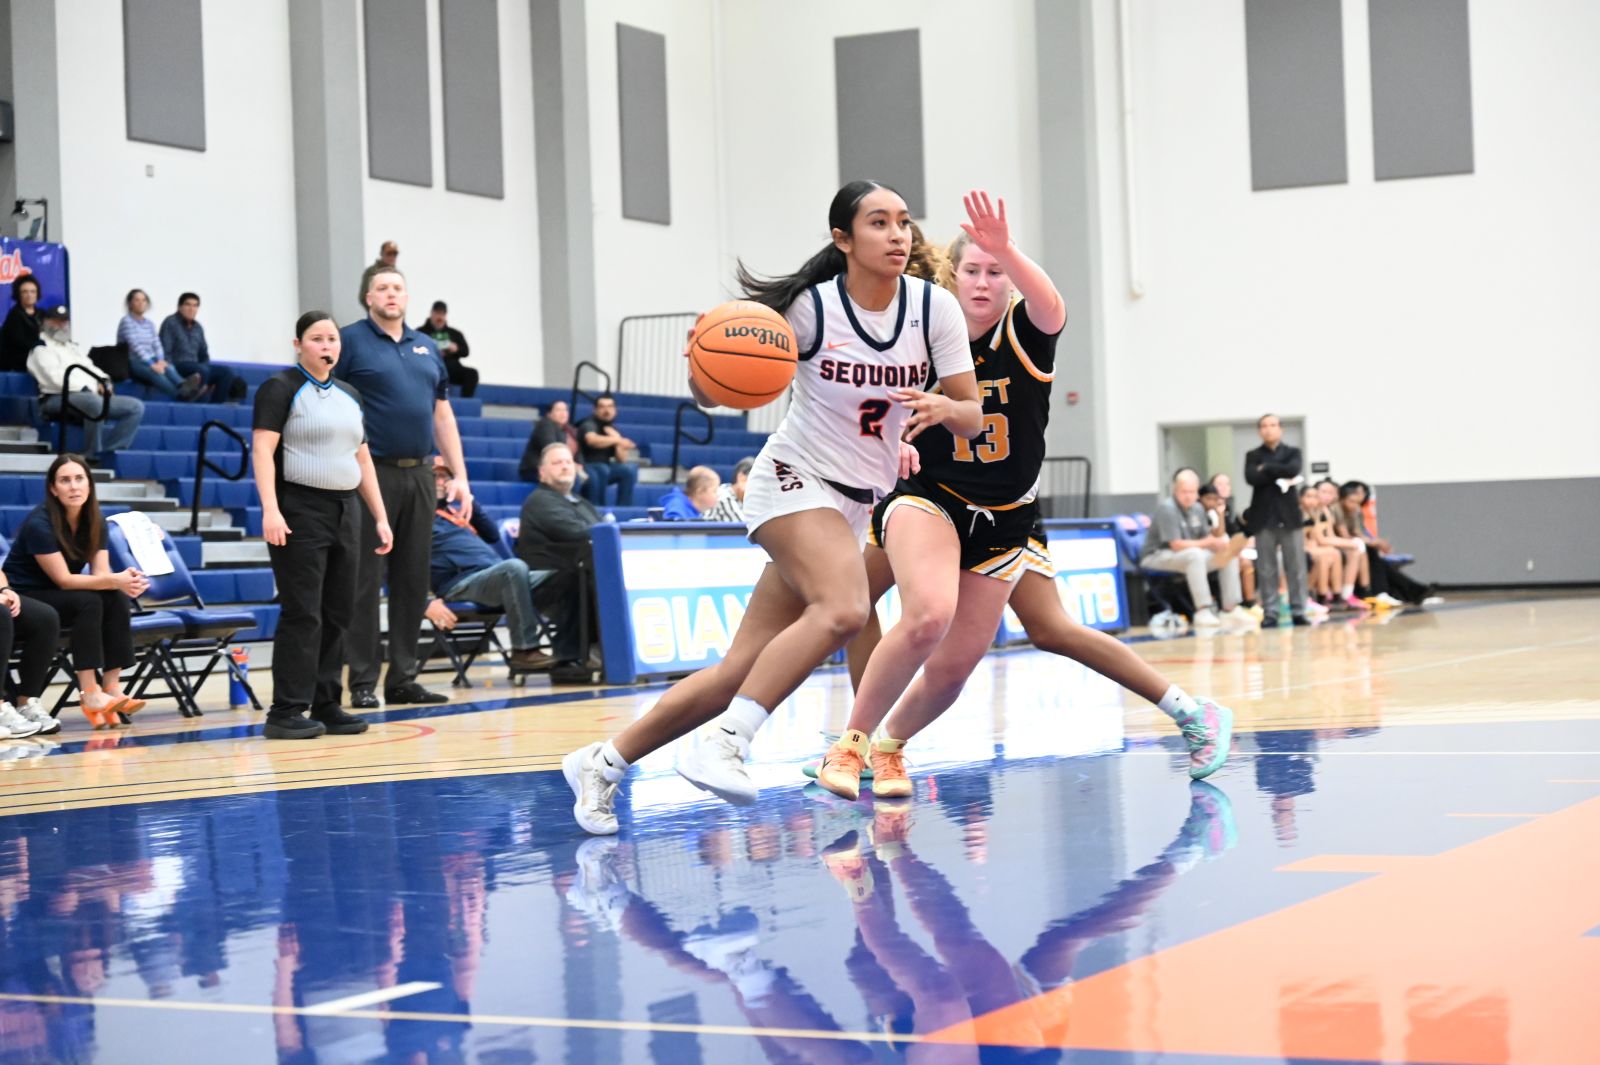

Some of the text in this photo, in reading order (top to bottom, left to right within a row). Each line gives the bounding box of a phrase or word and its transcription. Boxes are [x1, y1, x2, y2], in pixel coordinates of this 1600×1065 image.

[0, 247, 32, 284] as
[724, 325, 791, 353] Wilson
[819, 358, 928, 388] SEQUOIAS
[977, 376, 1011, 406] FT
[858, 398, 892, 440] 2
[952, 412, 1011, 464] 13
